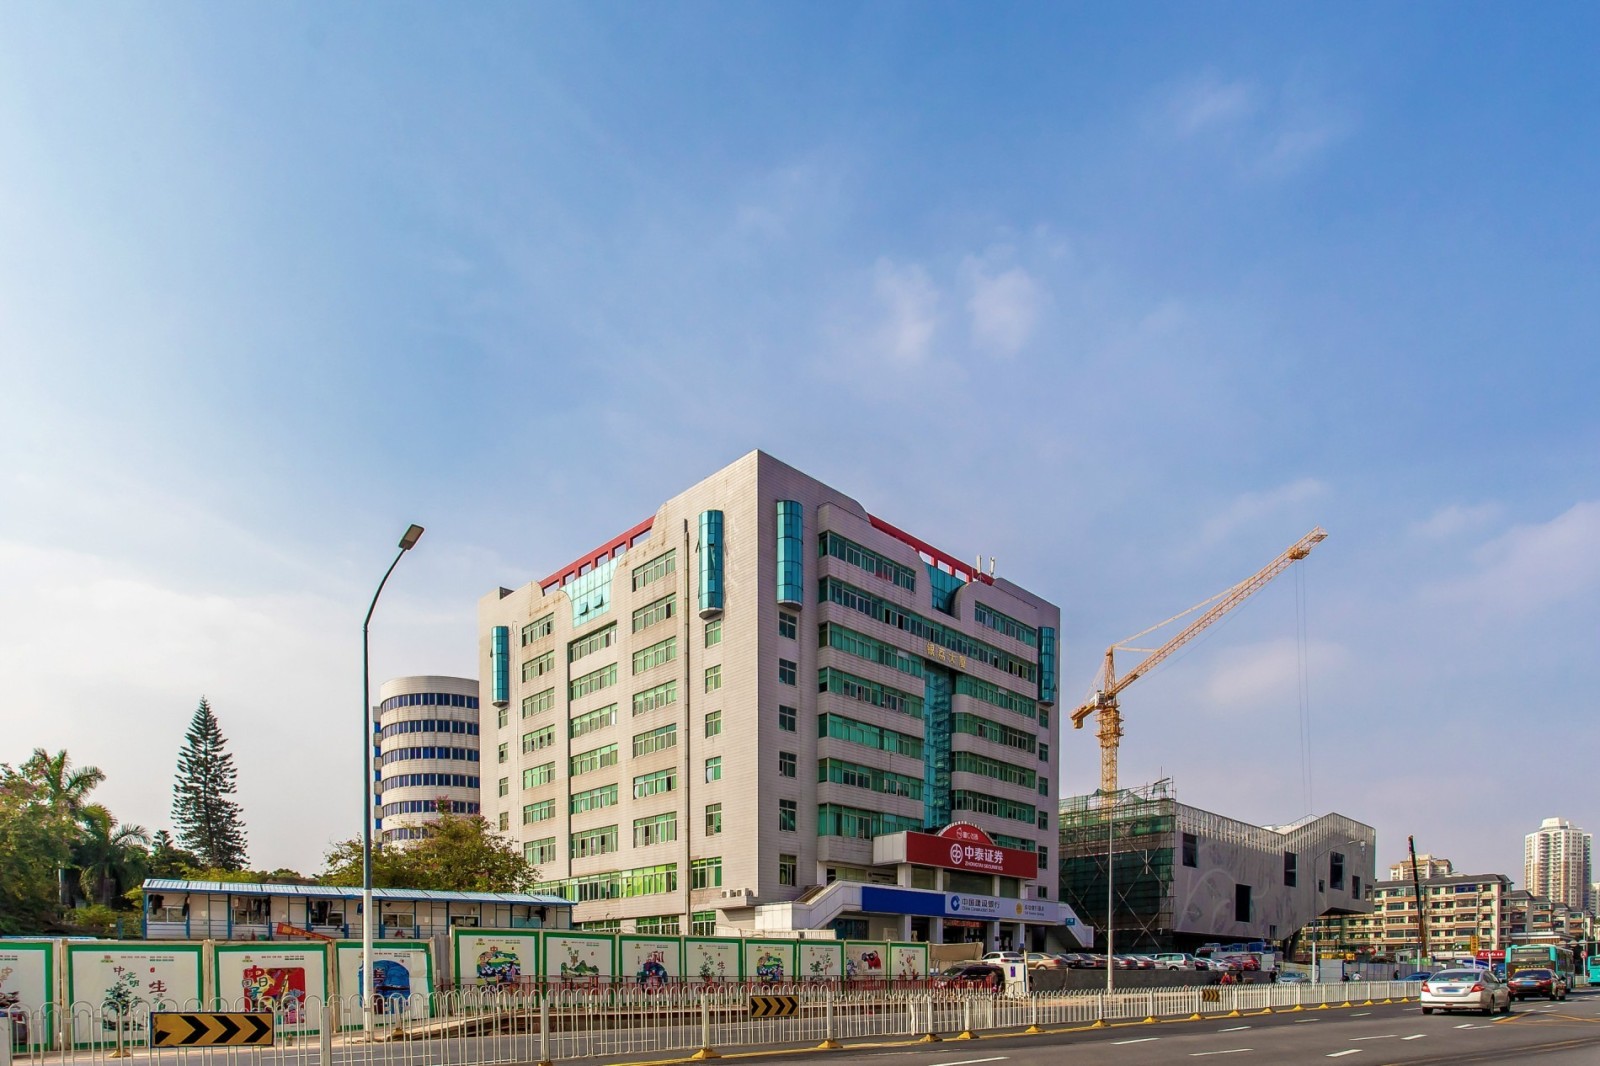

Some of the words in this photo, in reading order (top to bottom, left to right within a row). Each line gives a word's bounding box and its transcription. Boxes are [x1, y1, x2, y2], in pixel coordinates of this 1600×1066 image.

[964, 845, 1004, 864] 中泰证券
[961, 898, 1000, 909] 中国建设银行
